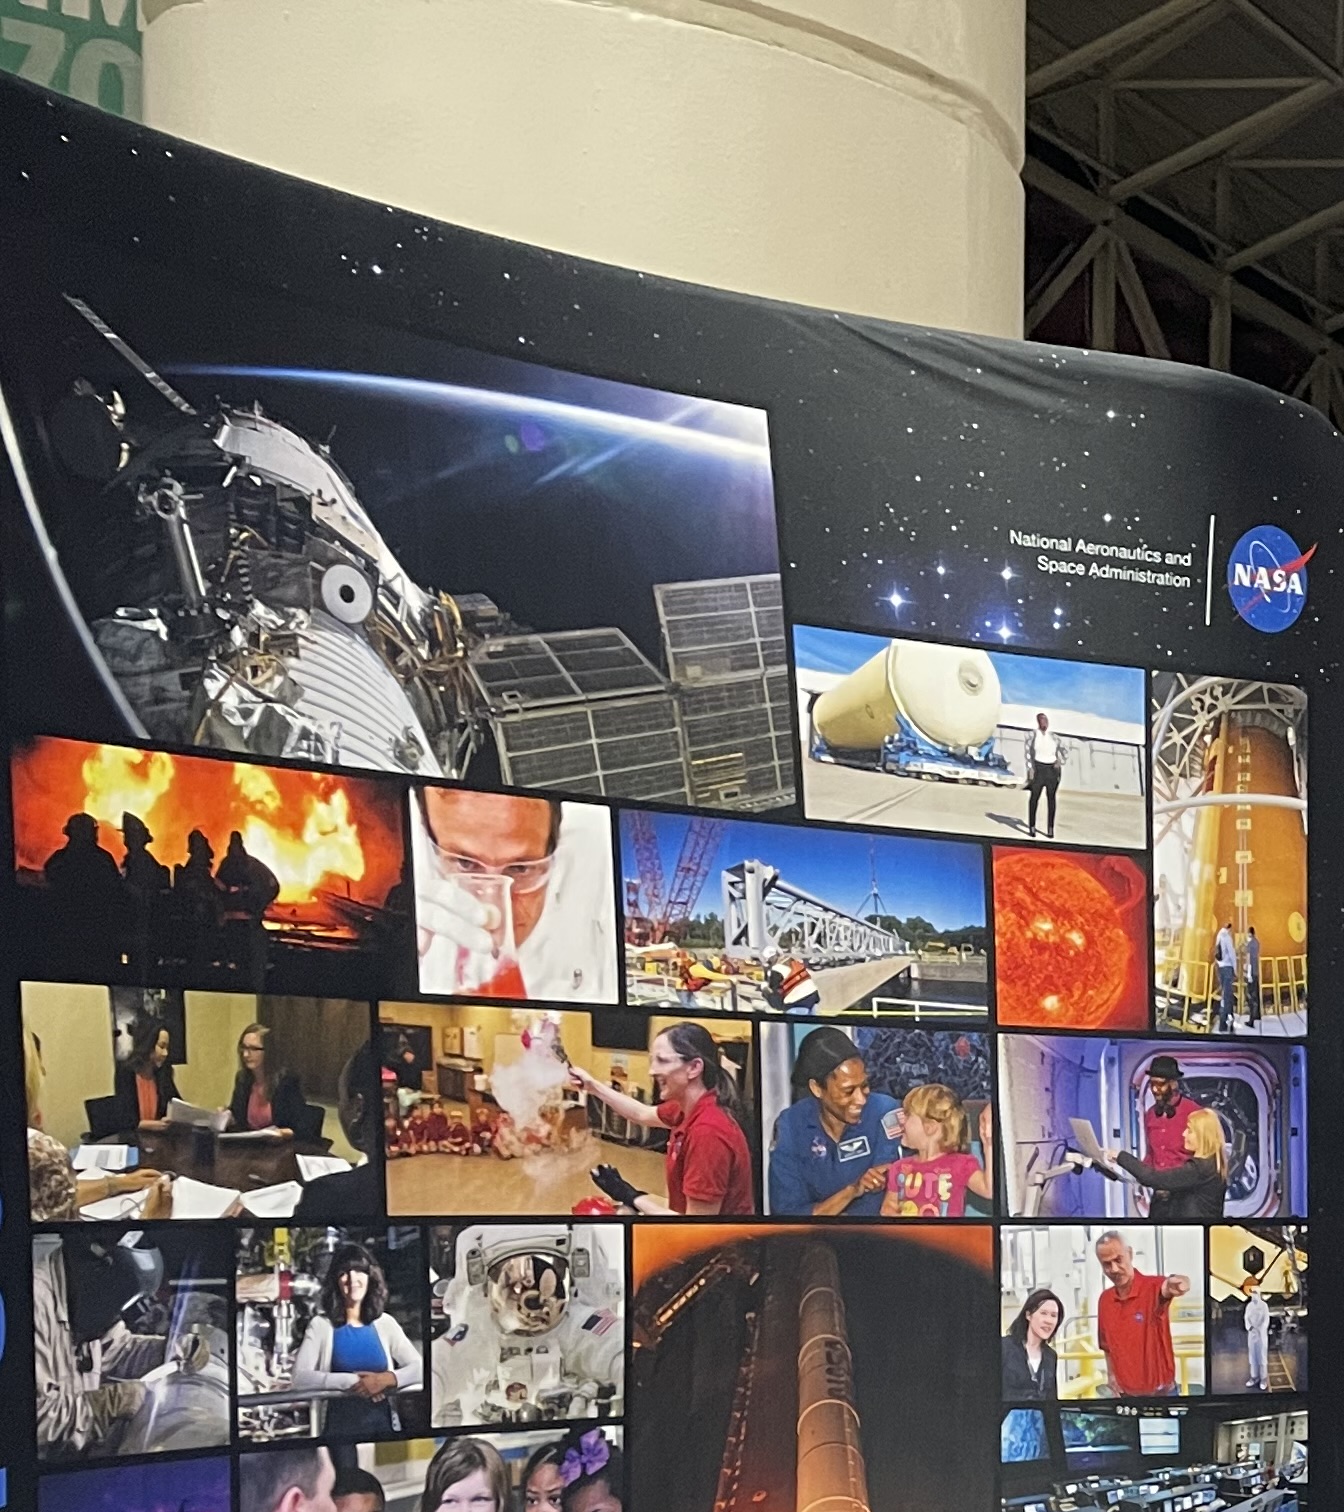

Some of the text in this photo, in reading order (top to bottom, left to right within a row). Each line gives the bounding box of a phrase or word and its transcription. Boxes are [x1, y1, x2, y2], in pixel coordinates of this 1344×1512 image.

[1009, 529, 1192, 567] National Aeronautics and
[1037, 555, 1191, 588] Space Administration
[1233, 562, 1304, 596] NASA
